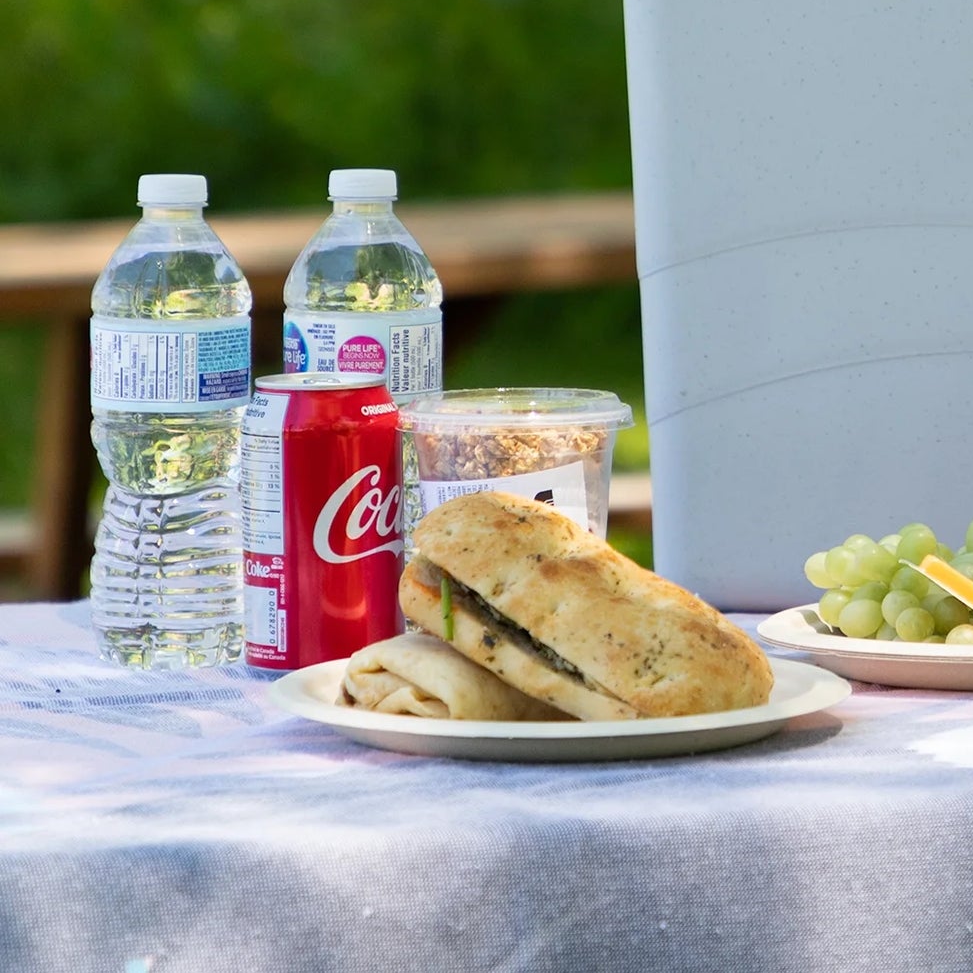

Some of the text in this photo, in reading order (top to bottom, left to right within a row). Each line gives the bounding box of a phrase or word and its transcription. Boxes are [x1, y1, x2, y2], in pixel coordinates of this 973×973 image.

[342, 344, 361, 352] PURE
[391, 333, 400, 392] Nutrition Facts
[259, 396, 268, 407] Facts
[361, 403, 396, 416] ORIGINAL
[246, 559, 270, 578] Coke
